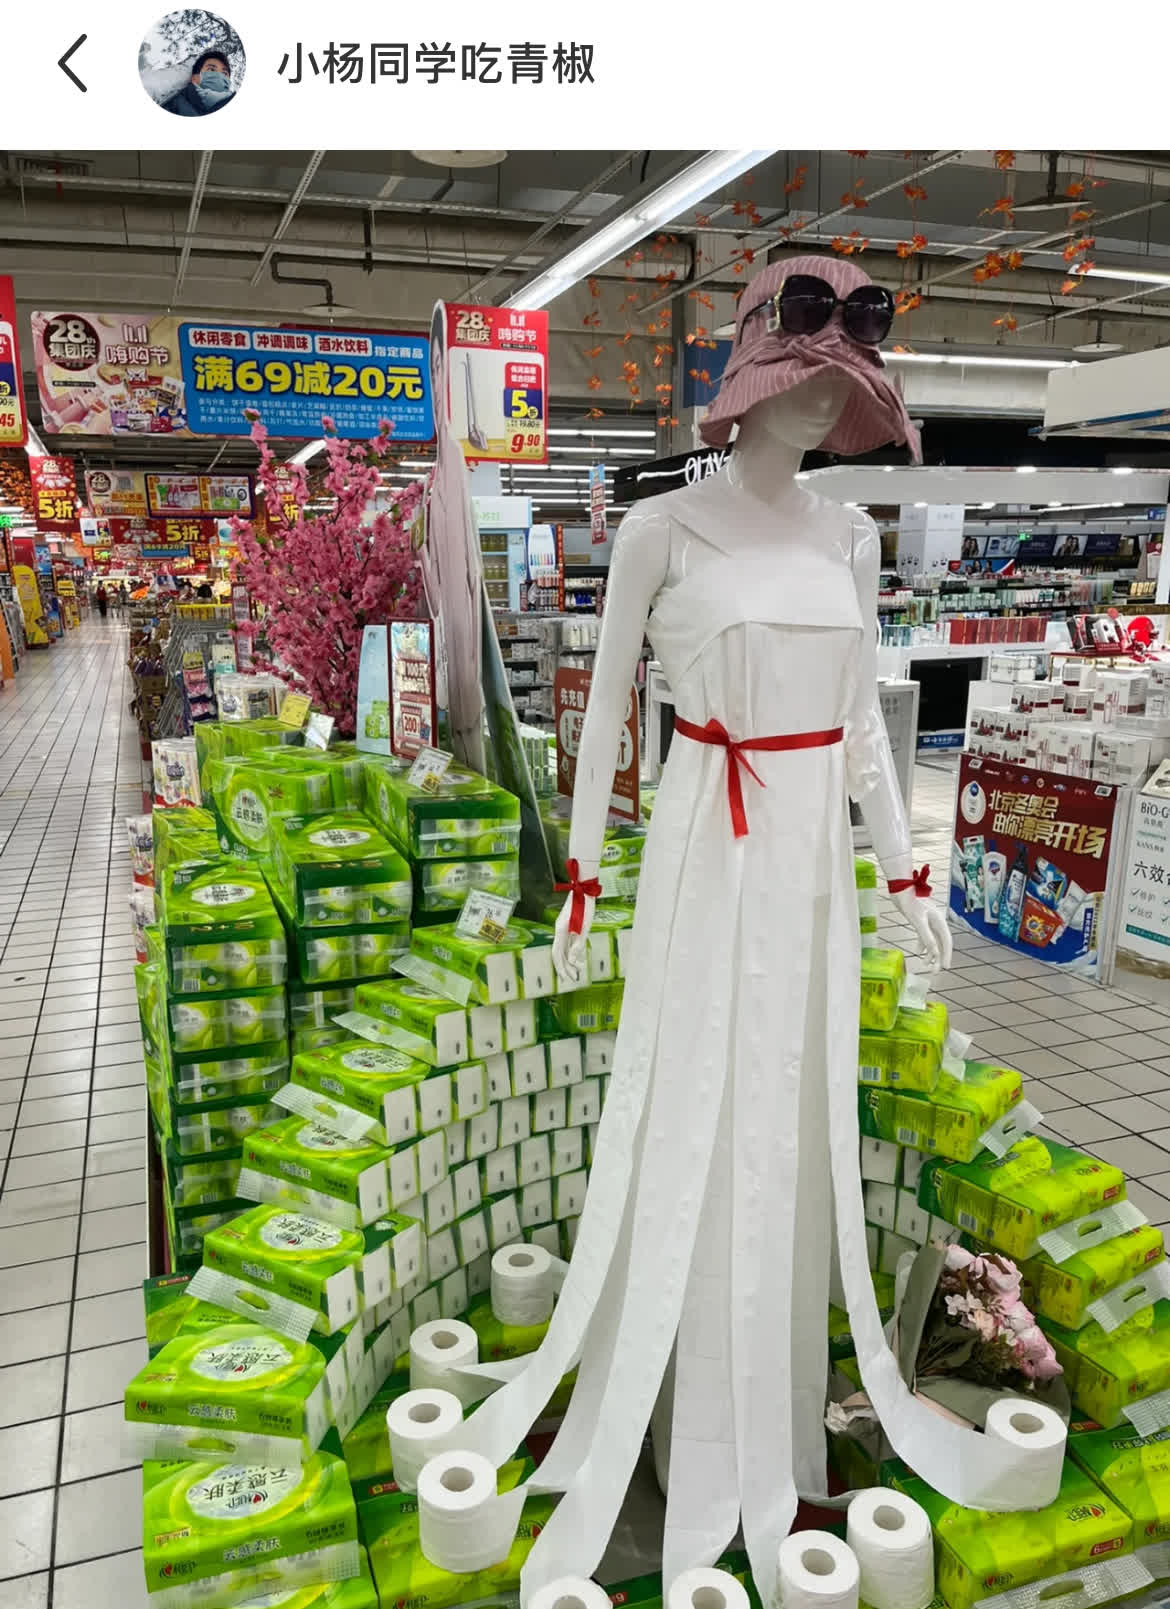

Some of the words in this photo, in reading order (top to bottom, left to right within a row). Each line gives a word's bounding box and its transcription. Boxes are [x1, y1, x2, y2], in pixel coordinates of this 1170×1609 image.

[49, 344, 96, 360] 集团庆
[193, 331, 247, 347] 休闲零食
[257, 334, 308, 350] 冲调调味
[318, 338, 369, 354] 酒水饮料
[105, 346, 169, 366] 嗨购节
[194, 356, 423, 399] 满69减20元
[40, 498, 73, 518] 5折
[166, 524, 200, 542] 5折
[989, 790, 1060, 818] 北京冬奥会
[993, 811, 1107, 859] 由你漂亮开场
[204, 1468, 288, 1500] 云感柔肤
